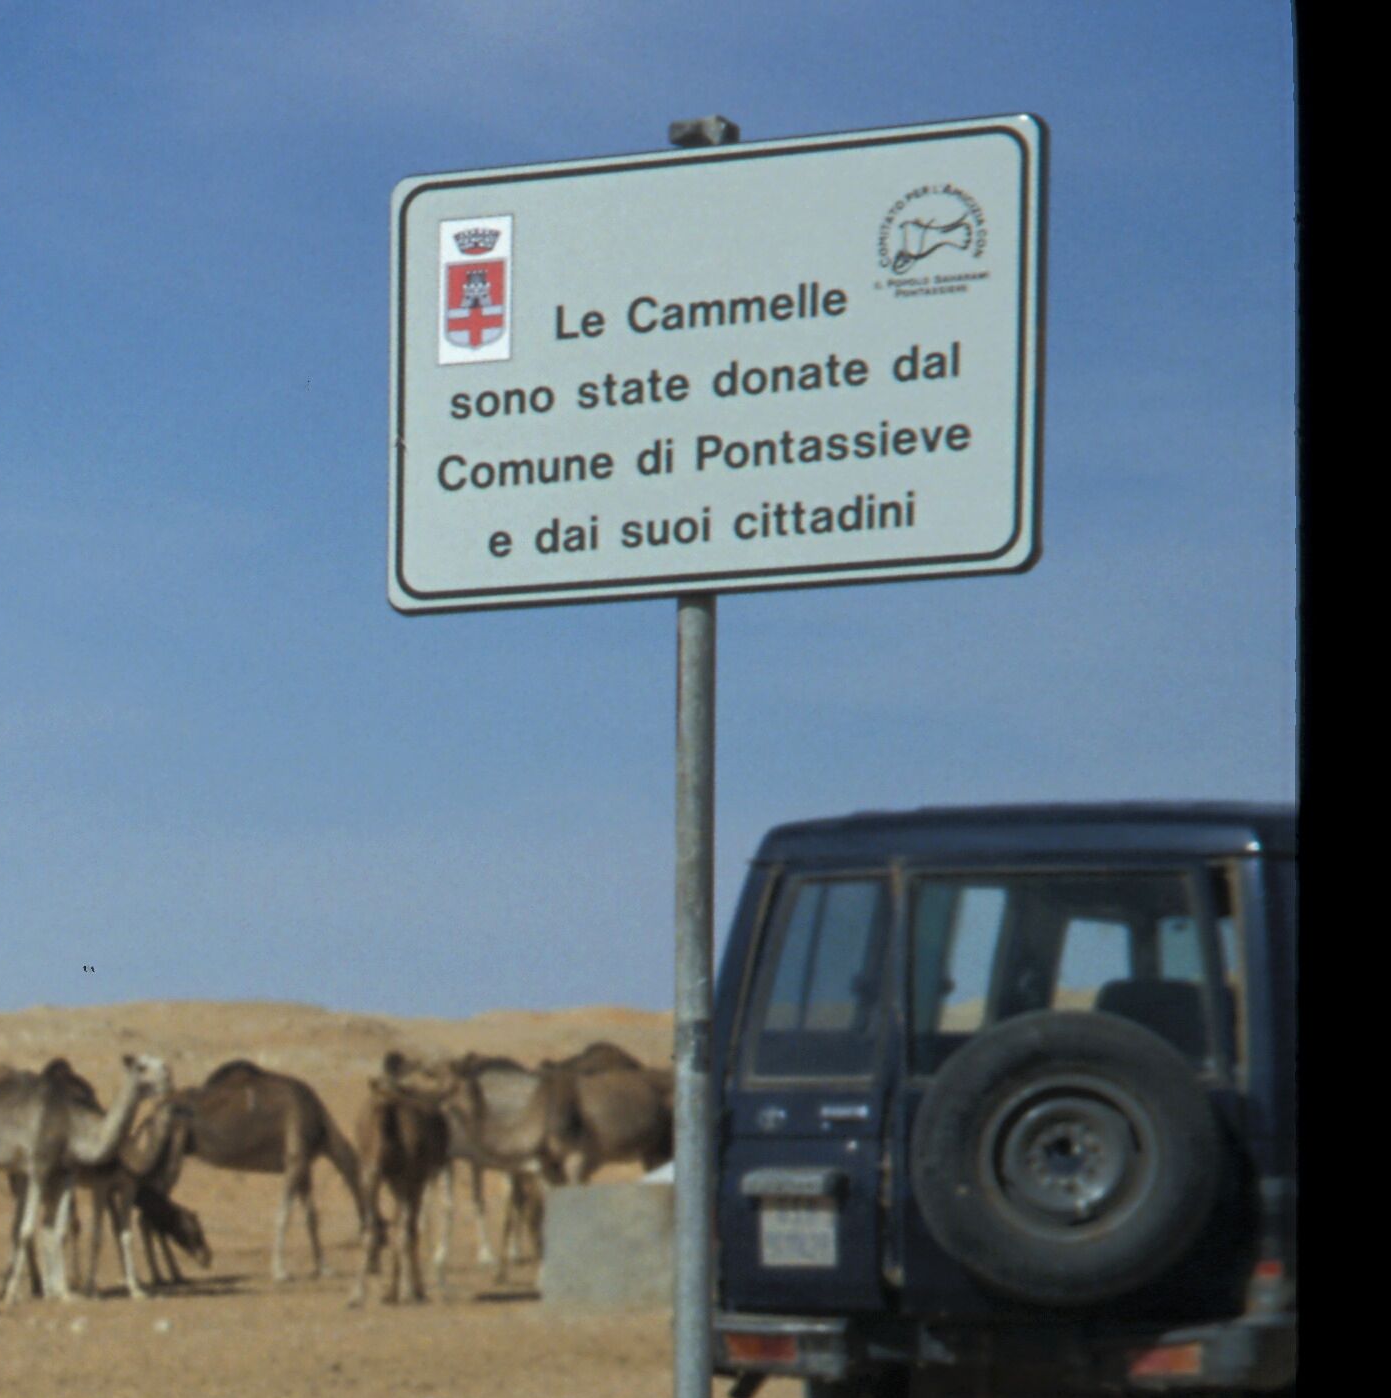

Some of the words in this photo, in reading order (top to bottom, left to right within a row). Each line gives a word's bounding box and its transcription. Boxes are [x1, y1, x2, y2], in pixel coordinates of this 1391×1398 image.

[556, 305, 605, 340] Le
[627, 281, 848, 334] Cammelle
[451, 385, 554, 420] sono
[577, 371, 690, 410] state
[713, 353, 869, 398] donate
[893, 342, 961, 383] dal
[437, 453, 614, 492] Comune
[637, 439, 674, 476] di
[696, 420, 971, 471] Pontassieve
[488, 531, 512, 558] e
[535, 515, 599, 554] dai
[621, 507, 711, 549] suoi
[733, 492, 915, 541] cittadini
